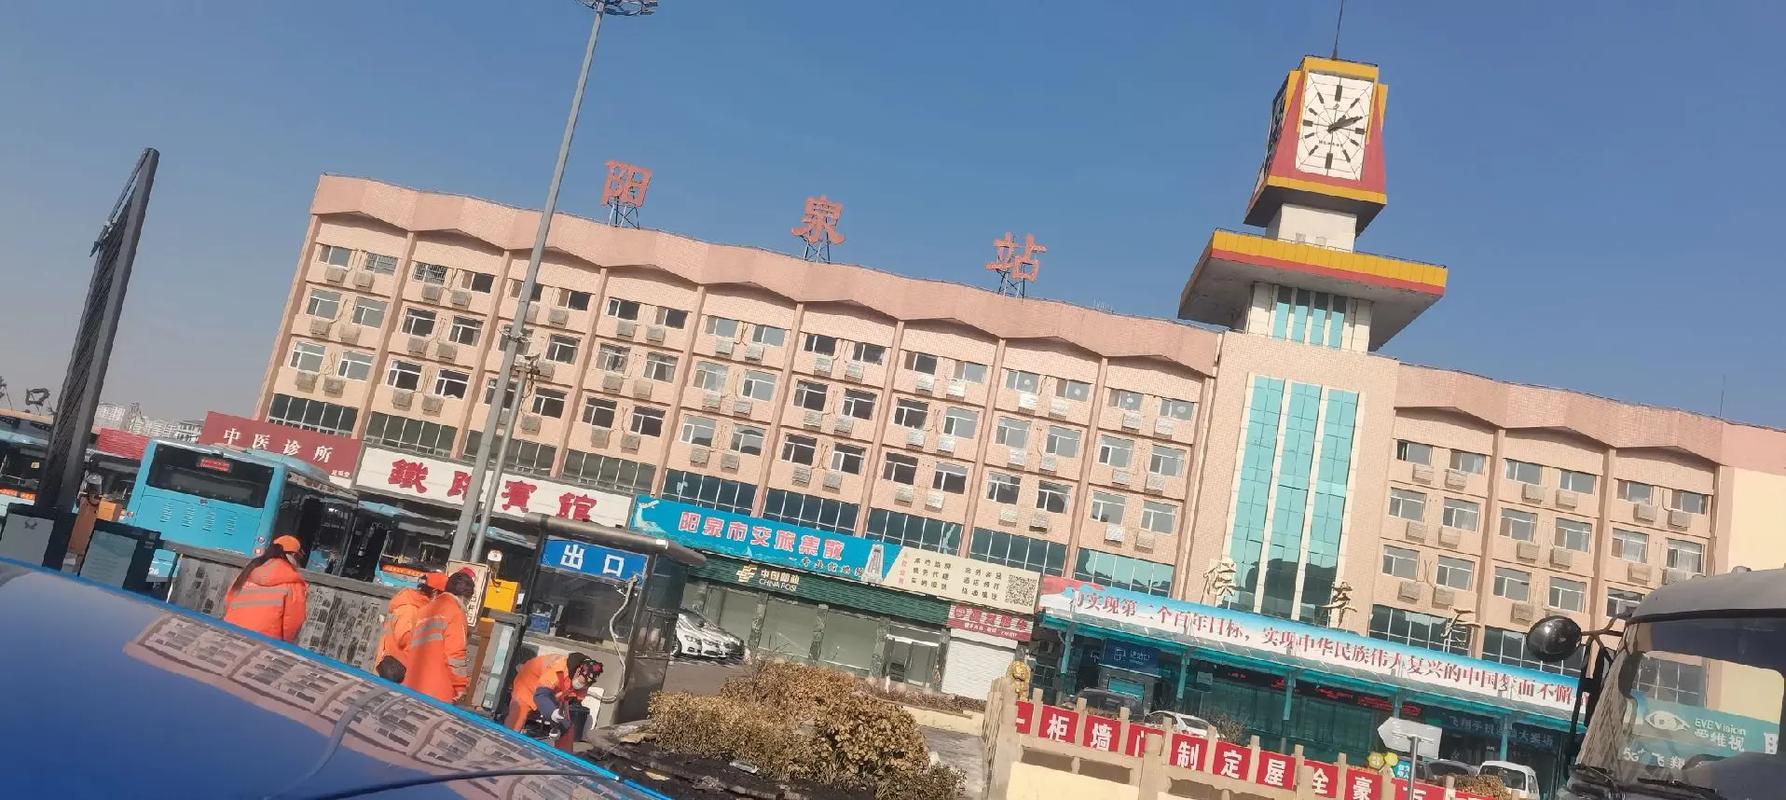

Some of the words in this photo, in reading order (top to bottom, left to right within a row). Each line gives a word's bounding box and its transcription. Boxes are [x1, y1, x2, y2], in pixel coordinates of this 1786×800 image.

[602, 158, 1047, 283] 阳泉站
[223, 427, 334, 463] 中医诊所
[678, 511, 845, 561] 阳泉市交旅集散
[560, 543, 625, 577] 出口
[760, 568, 800, 585] 中国邮政
[758, 577, 781, 589] CHINA
[1694, 718, 1713, 730] EVE
[1713, 720, 1747, 736] Vision
